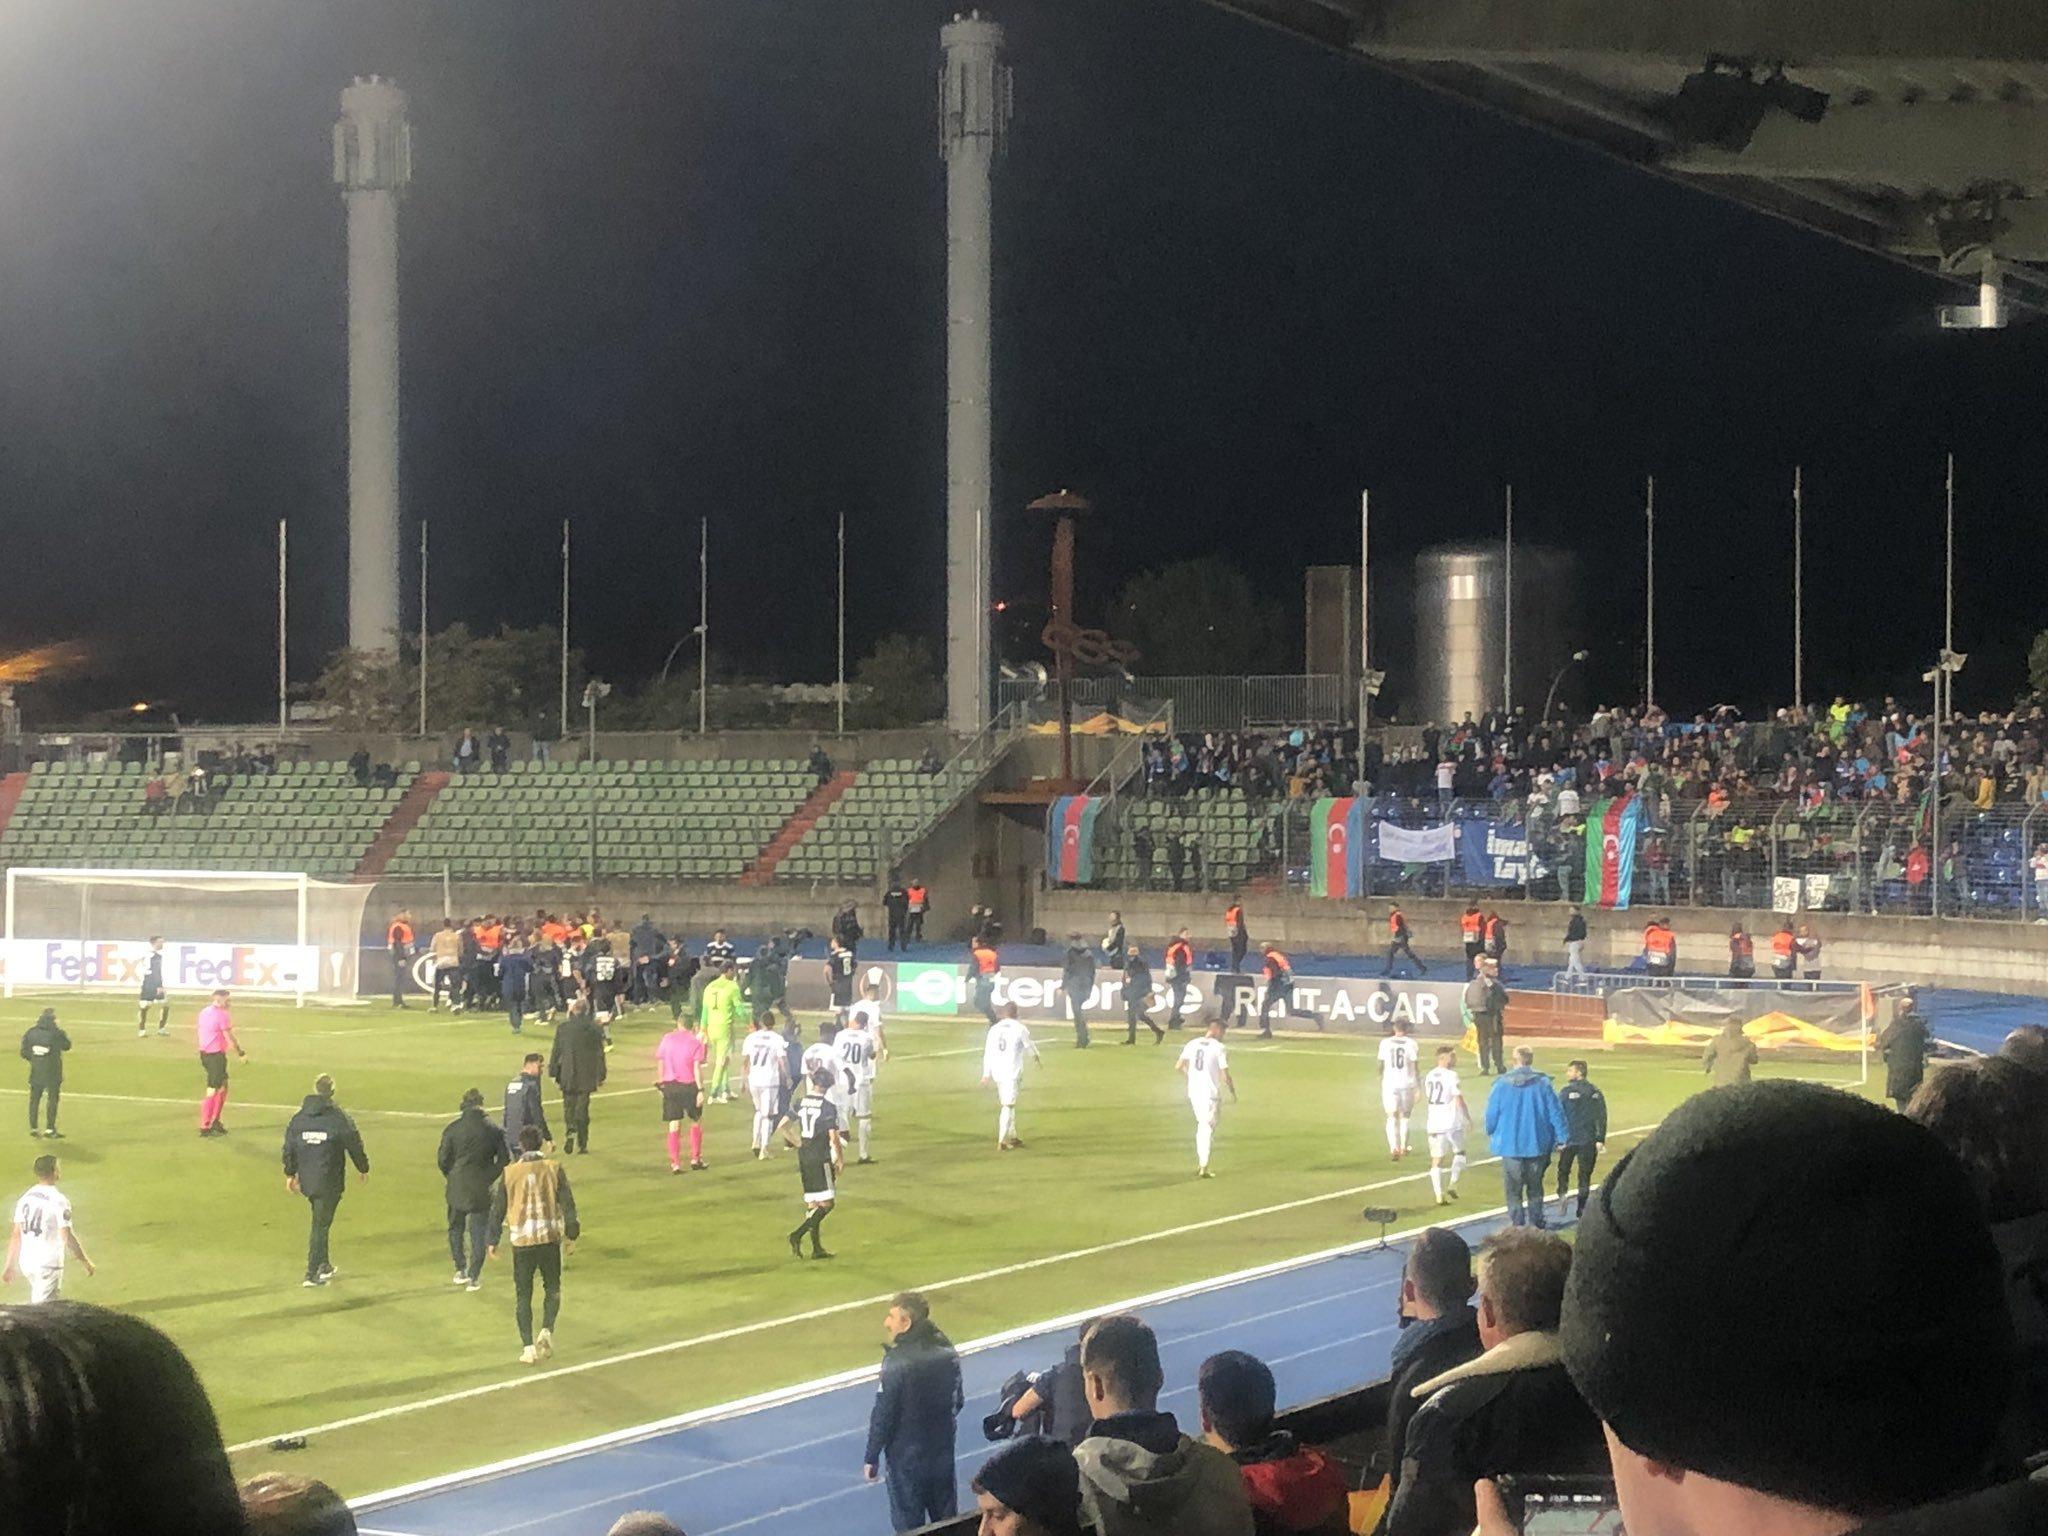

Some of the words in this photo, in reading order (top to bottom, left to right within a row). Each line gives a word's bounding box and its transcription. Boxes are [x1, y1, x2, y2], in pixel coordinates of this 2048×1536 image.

[46, 943, 142, 982] FedEx
[180, 946, 278, 986] FedEx
[897, 968, 1203, 1020] enterprse
[842, 1042, 861, 1065] 20
[1195, 1049, 1205, 1071] 8
[1390, 1047, 1406, 1070] 16
[1428, 1081, 1445, 1105] 22
[798, 1107, 822, 1139] 17
[23, 1203, 43, 1237] 34
